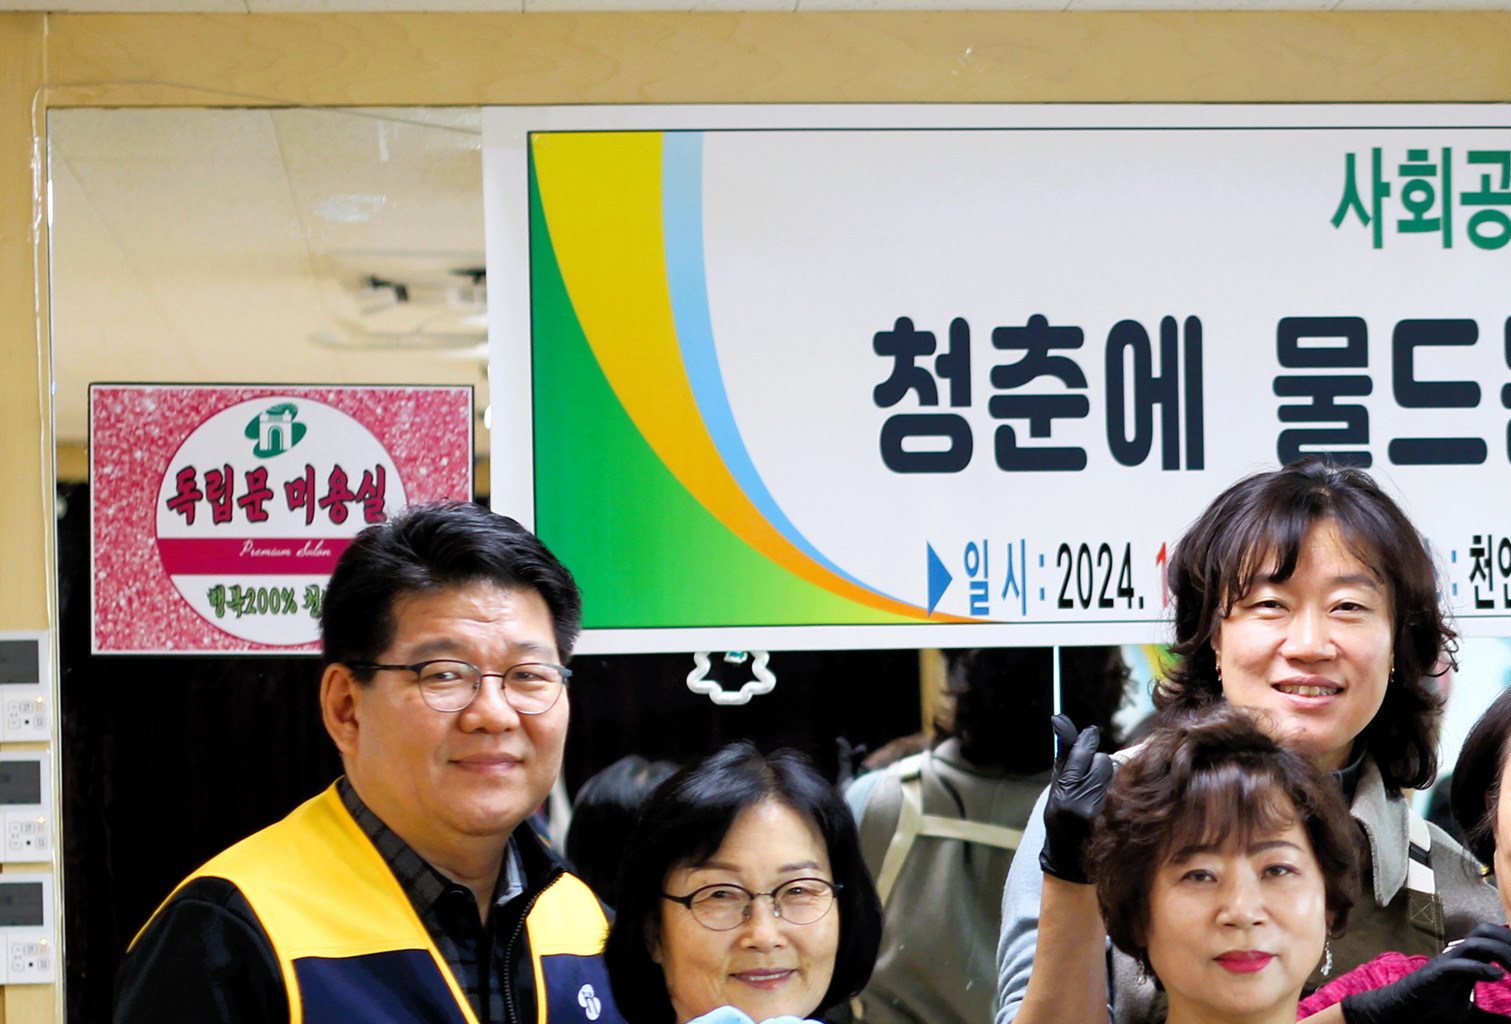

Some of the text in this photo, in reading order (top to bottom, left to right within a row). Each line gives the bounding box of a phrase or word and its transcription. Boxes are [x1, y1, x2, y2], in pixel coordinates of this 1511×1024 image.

[872, 314, 1205, 474] 청춘에
[166, 463, 387, 526] 독립문 미용실
[1056, 542, 1144, 610] 2024.
